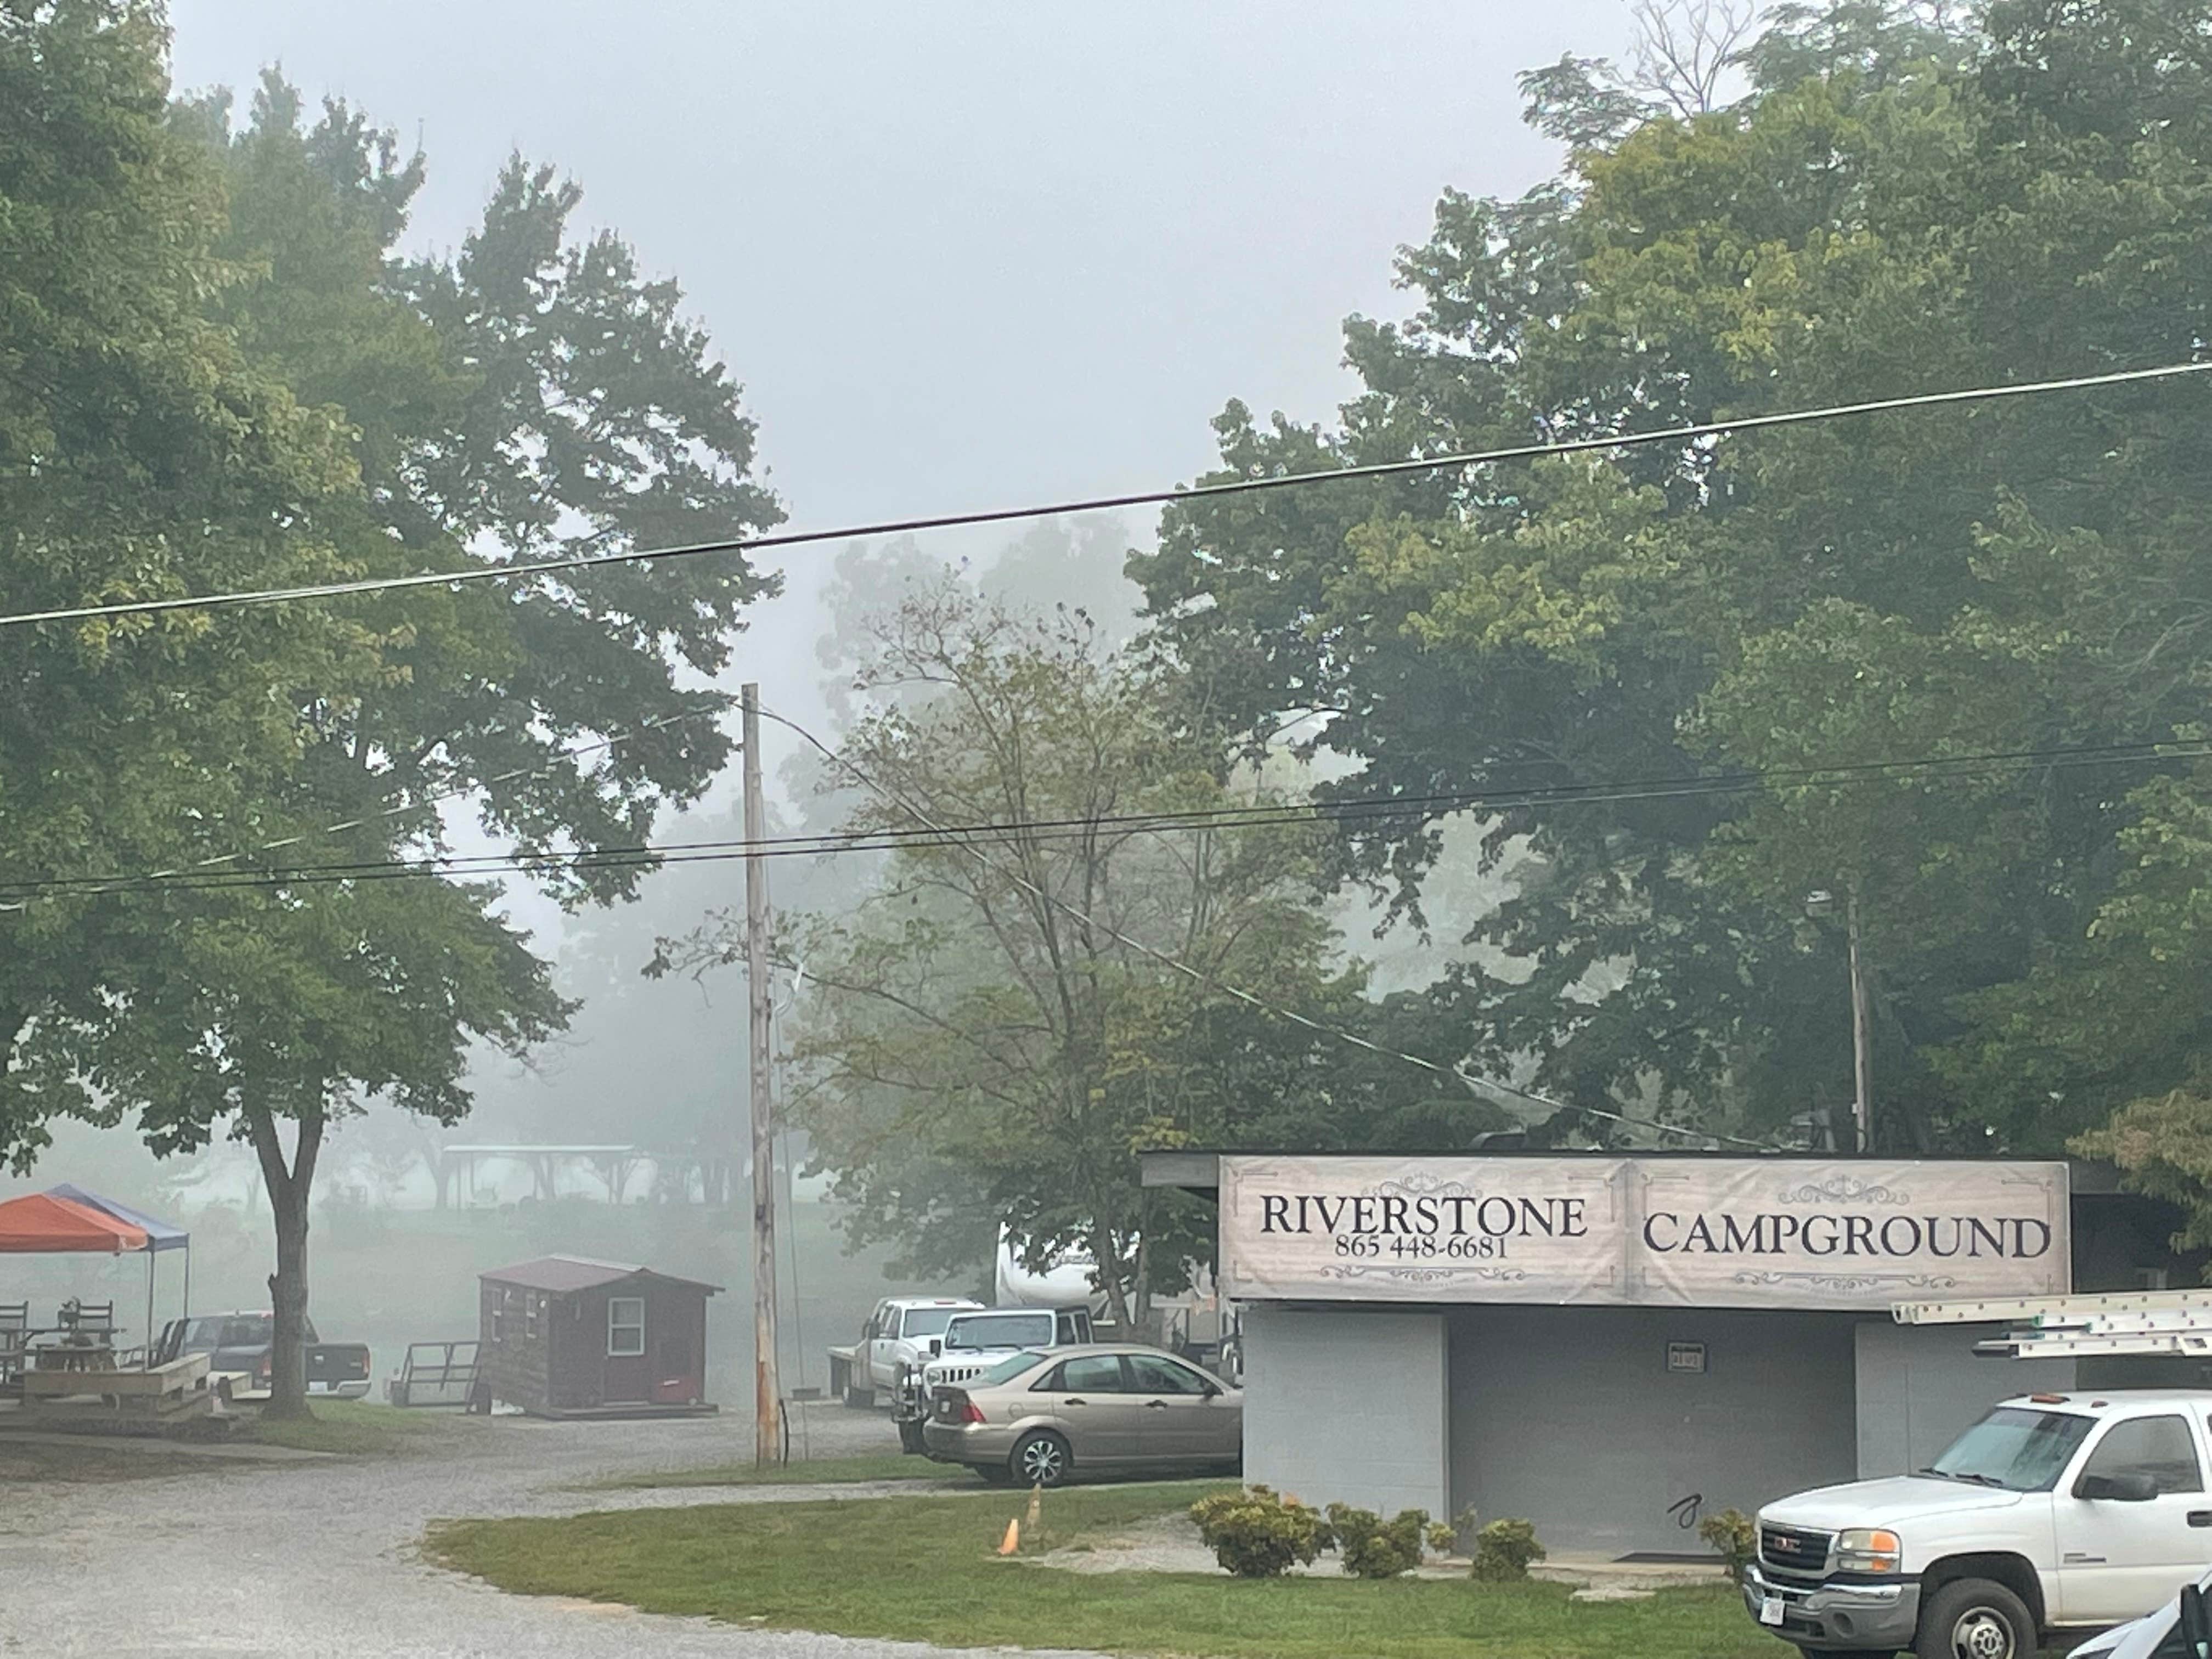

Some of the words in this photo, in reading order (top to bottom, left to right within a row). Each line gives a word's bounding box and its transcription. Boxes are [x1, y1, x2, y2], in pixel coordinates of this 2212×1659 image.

[1260, 1195, 1588, 1237] RIVERSTONE
[1644, 1212, 2051, 1258] CAMPGROUND
[1335, 1235, 1380, 1257] 865
[1390, 1236, 1508, 1259] 448-6681
